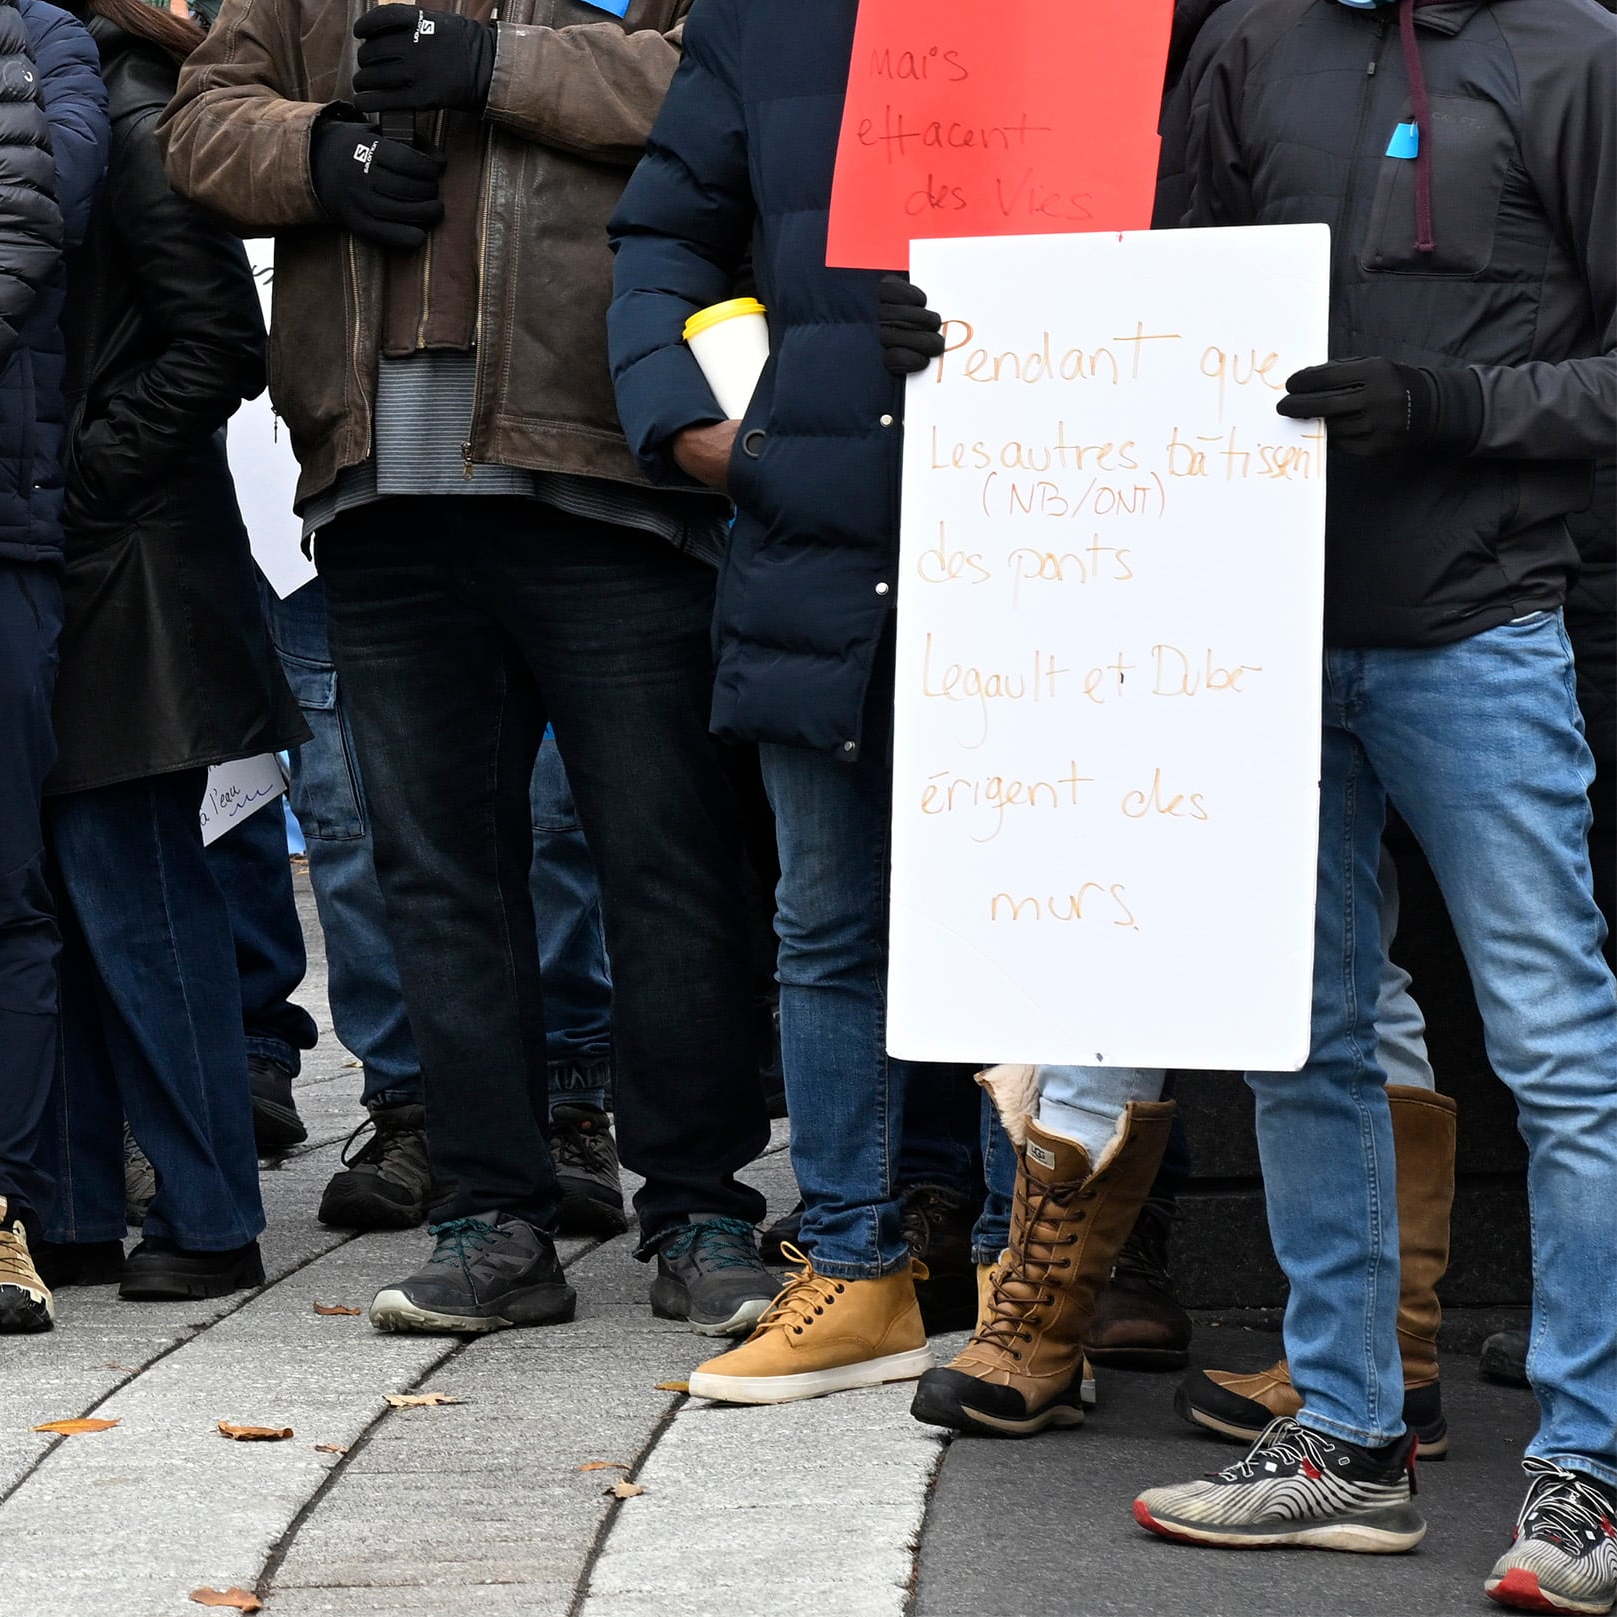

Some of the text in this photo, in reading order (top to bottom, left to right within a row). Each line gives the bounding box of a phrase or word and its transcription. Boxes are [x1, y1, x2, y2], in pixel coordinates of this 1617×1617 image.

[905, 174, 968, 218] des
[937, 319, 1286, 423] Pendant que
[999, 420, 1141, 474] autres
[918, 519, 1134, 608] des ponts
[921, 631, 1263, 749] Legault et Dubé
[920, 756, 1209, 843] érigent des
